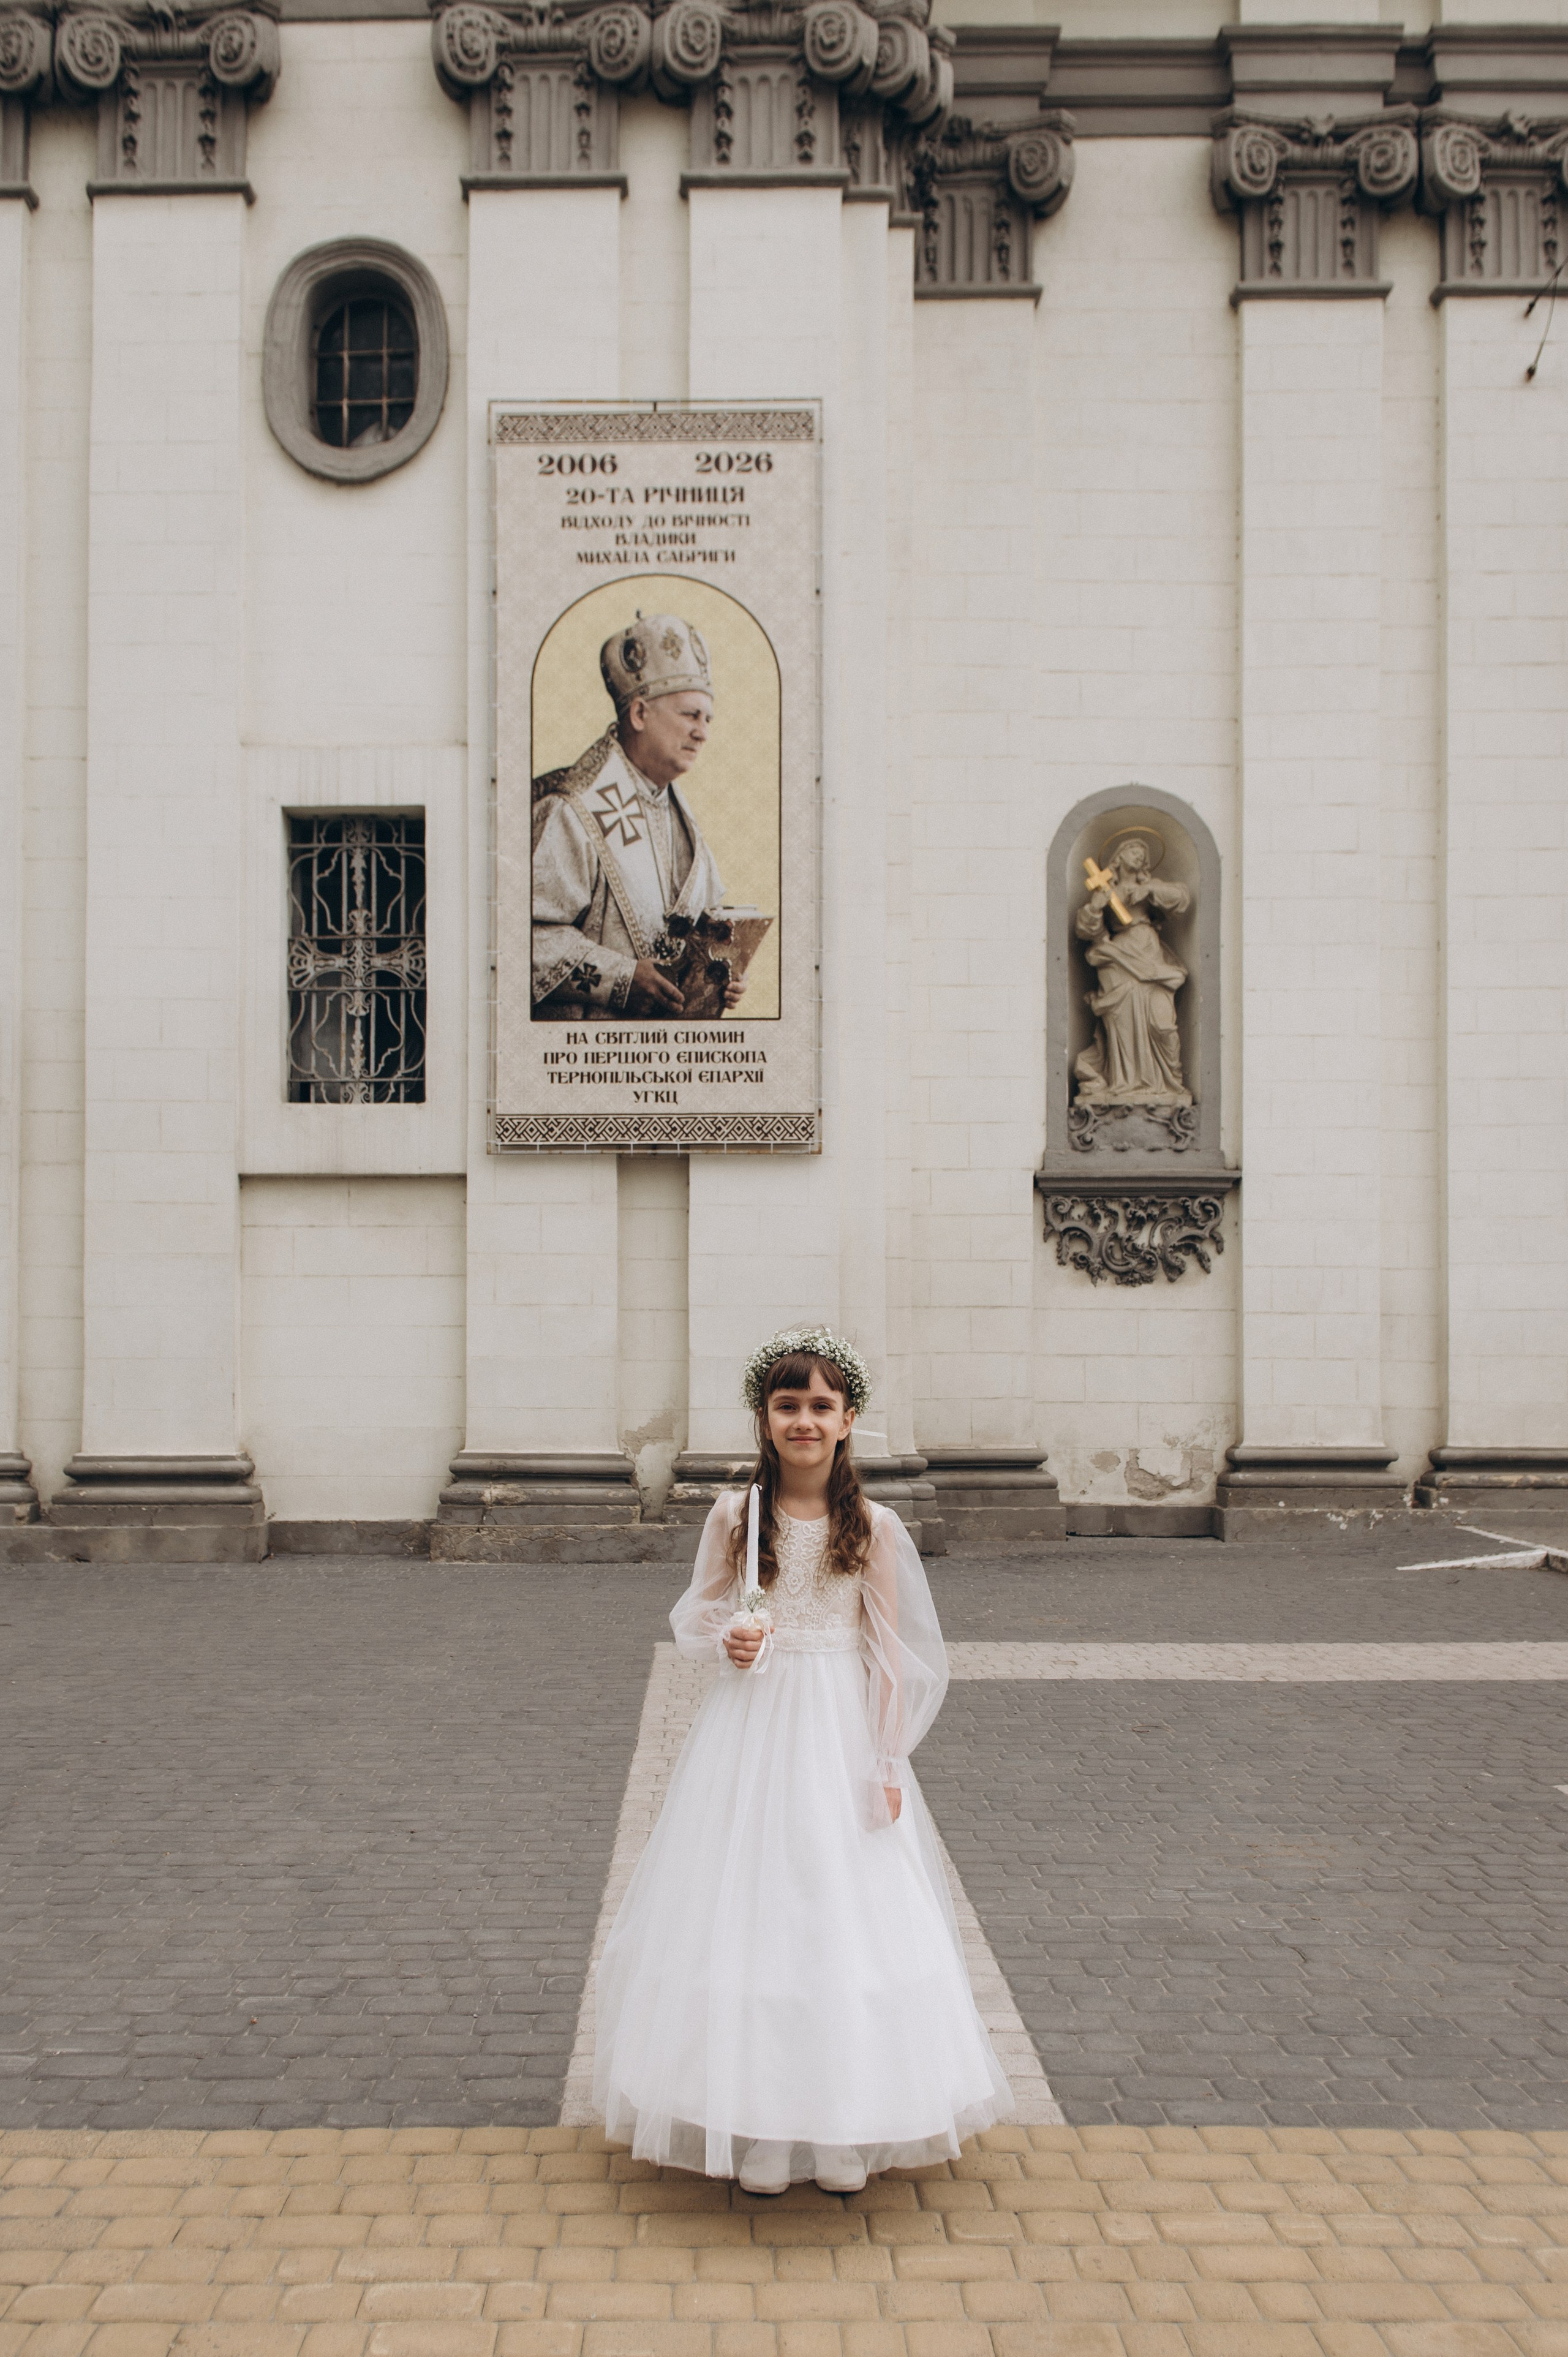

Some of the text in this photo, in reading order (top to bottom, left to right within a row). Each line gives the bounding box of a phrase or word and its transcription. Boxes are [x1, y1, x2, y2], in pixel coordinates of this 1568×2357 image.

[538, 451, 773, 475] 2006 2026
[566, 486, 744, 505] 20-ТА РІЧНИЦЯ
[561, 514, 750, 529] ВІДХОДУ ДО ВІЧНОСТІ
[615, 533, 696, 546] ВЛАДИКИ
[566, 1029, 744, 1044] НА СВІТЛИЙ СПОМИН
[544, 1050, 767, 1065] ПРО ПЕРШОГО ЄПИСКОПА
[547, 1068, 764, 1084] ТЕРНОПІЛЬСЬКОЇ ЄПАРХІЇ
[633, 1090, 678, 1105] УГКЦ
